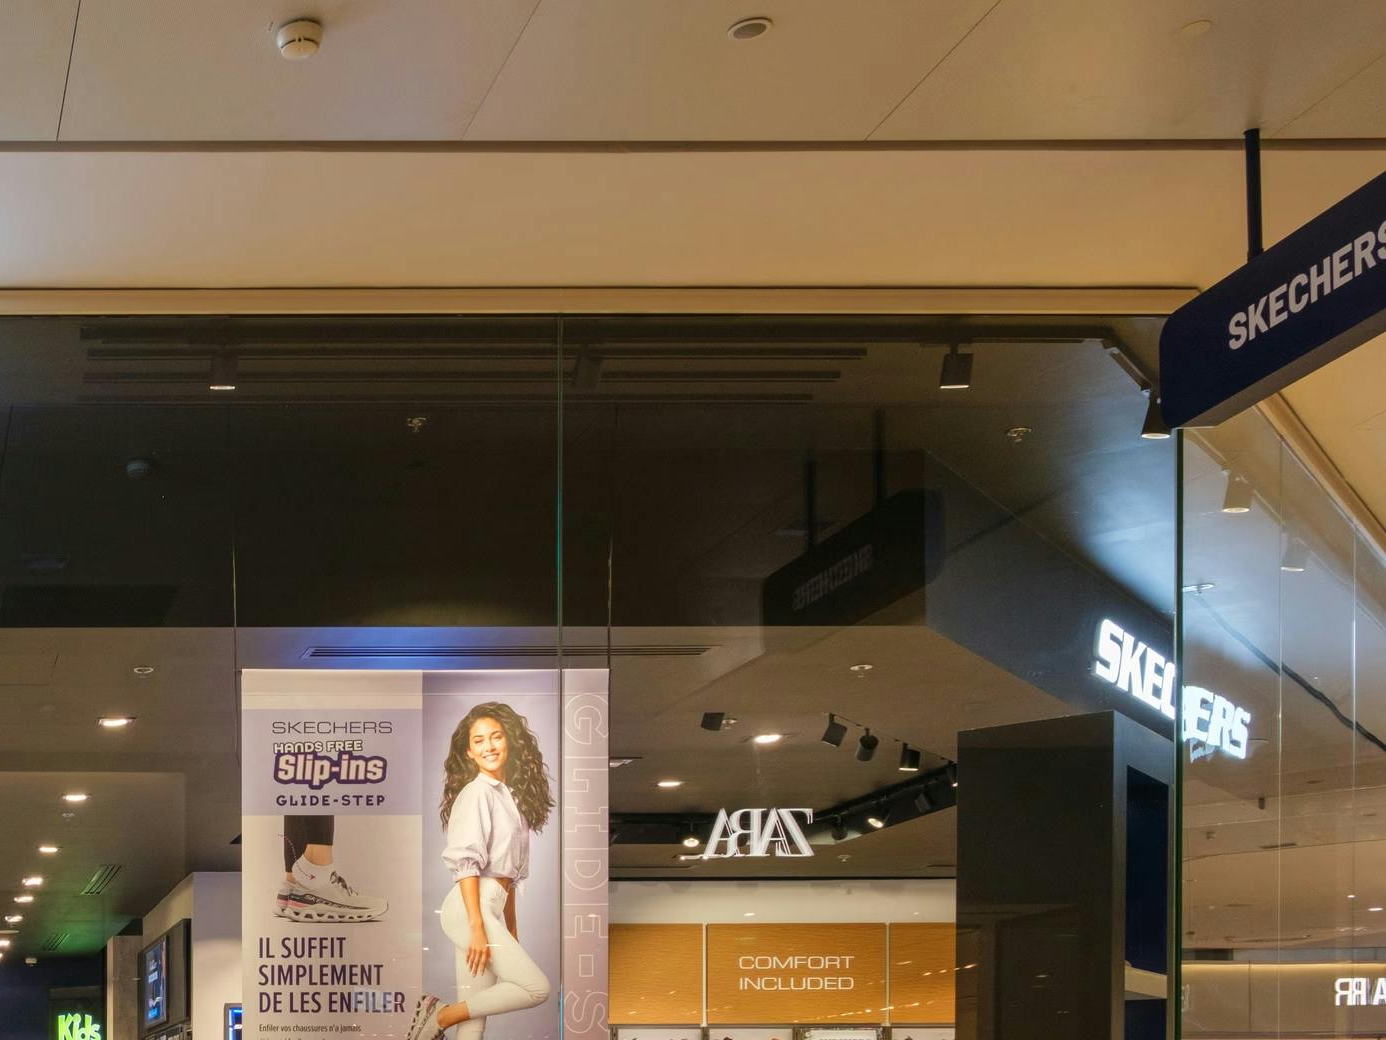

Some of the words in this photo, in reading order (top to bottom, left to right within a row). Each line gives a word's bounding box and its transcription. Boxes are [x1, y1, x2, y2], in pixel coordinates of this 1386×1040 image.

[272, 721, 393, 734] SKECHERS
[274, 741, 323, 754] HANDS
[326, 740, 363, 752] FREE
[275, 752, 386, 788] Slip-ins
[276, 795, 385, 806] GLIDE-STEP
[259, 937, 275, 959] IL
[281, 937, 346, 959] SUFFIT
[739, 956, 854, 969] COMFORT
[258, 964, 384, 986] SIMPLEMENT
[739, 977, 854, 991] INCLUDED
[259, 991, 283, 1013] DE
[290, 991, 322, 1013] LES
[328, 991, 406, 1013] ENFILER
[57, 1013, 102, 1040] Kids
[258, 1024, 279, 1033] Enfiler
[280, 1025, 292, 1033] vos
[292, 1024, 328, 1033] chaussures
[340, 1024, 362, 1034] jamais
